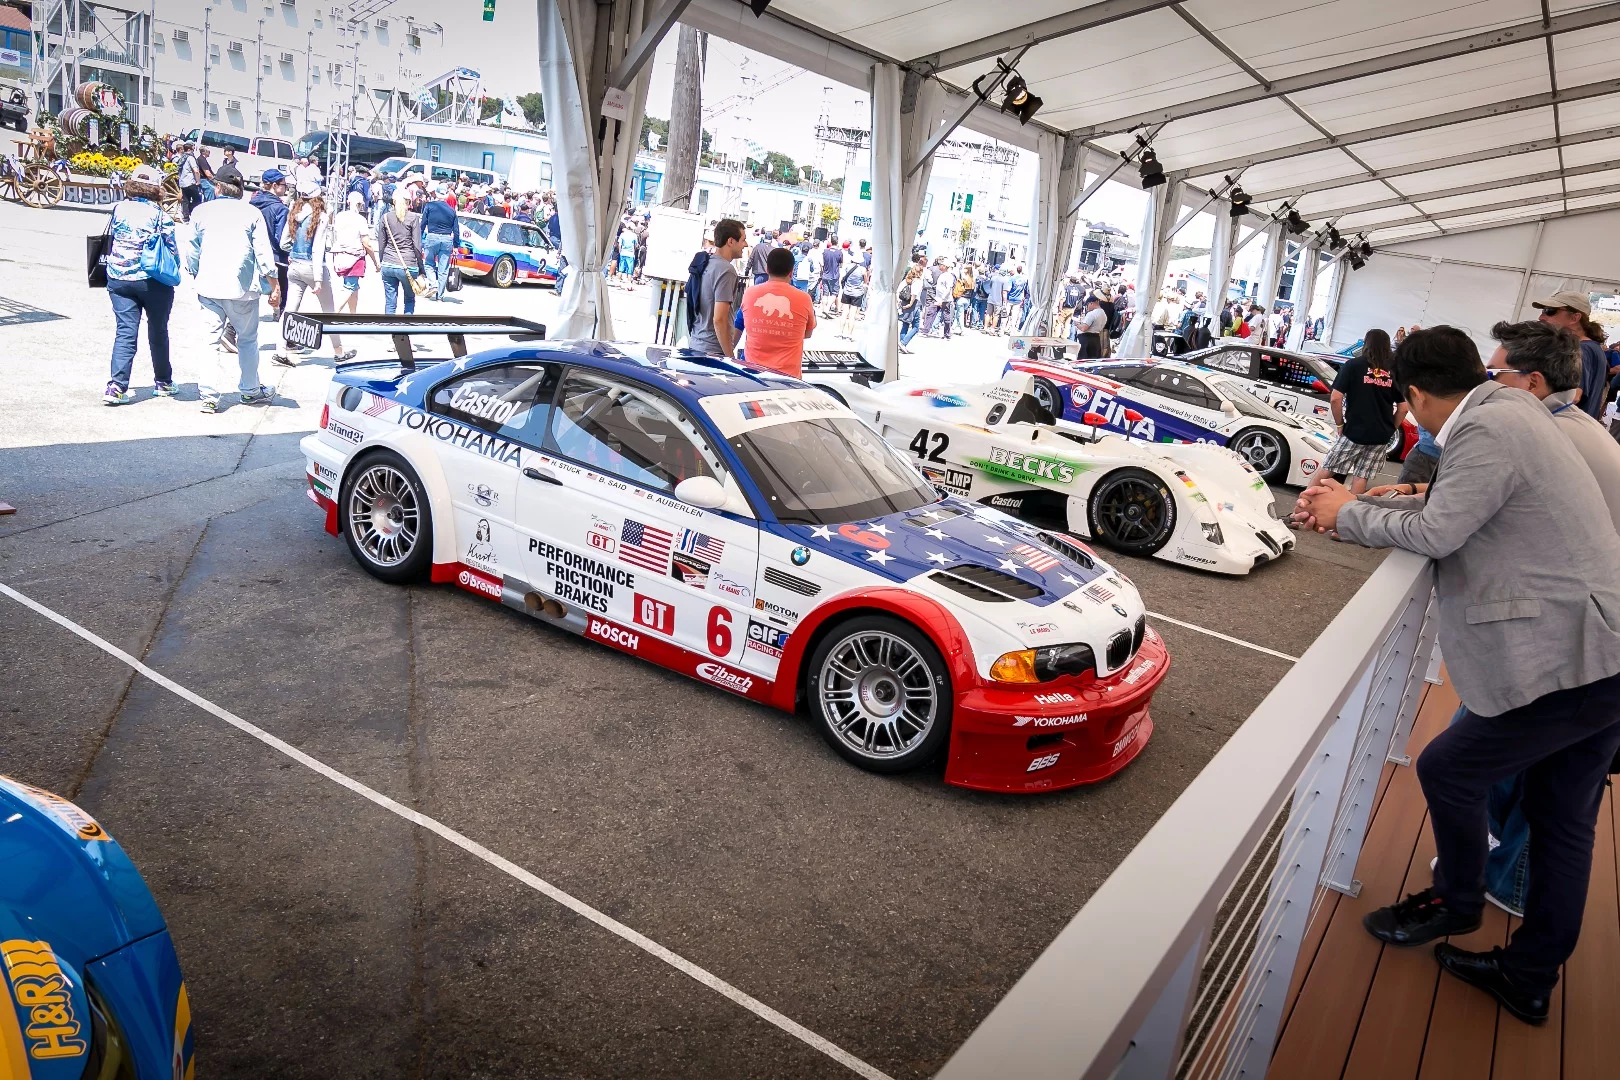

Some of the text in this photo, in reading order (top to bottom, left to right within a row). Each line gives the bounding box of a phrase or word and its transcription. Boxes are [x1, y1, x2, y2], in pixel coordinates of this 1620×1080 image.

[537, 258, 547, 275] 2
[284, 314, 319, 348] Castrol
[751, 327, 794, 337] RESERVE
[752, 318, 794, 328] ONWARD
[830, 352, 861, 364] parts
[450, 381, 522, 425] Castrol
[921, 390, 970, 408] BMW Motorsport
[1073, 389, 1089, 401] FINA
[1088, 389, 1155, 442] FINA
[1158, 402, 1209, 426] powered by BMW
[328, 422, 364, 443] stand21
[397, 405, 522, 468] YOKOHAMA
[908, 428, 950, 465] 42
[551, 459, 582, 475] H. STUCK
[969, 460, 990, 471] DON'T
[990, 464, 1010, 476] DRINK
[987, 446, 1075, 484] BECK'S
[1302, 462, 1317, 471] FINA
[598, 476, 628, 491] B. SAID
[945, 471, 971, 488] LMP
[646, 493, 704, 518] B. AUBERLEN
[990, 495, 1024, 508] Castrol
[592, 534, 609, 549] GT
[838, 525, 892, 550] 6
[467, 543, 498, 564] Kurt's
[528, 537, 635, 589] PERFORMANCE
[1184, 554, 1218, 565] MICHELIN
[465, 557, 498, 575] RESTAURANT
[546, 561, 614, 598] FRICTION
[554, 580, 608, 613] BRAKES
[725, 585, 741, 596] MANS
[641, 598, 667, 629] GT
[764, 601, 799, 619] MOTON
[590, 619, 640, 650] BOSCH
[706, 605, 733, 658] 6
[749, 623, 779, 645] elf
[747, 639, 775, 655] RACING
[695, 662, 753, 688] Eibach
[1033, 692, 1076, 705] Hella
[1032, 713, 1088, 727] YOKOHAMA
[1026, 752, 1061, 772] BBS
[15, 976, 87, 1060] H&R
